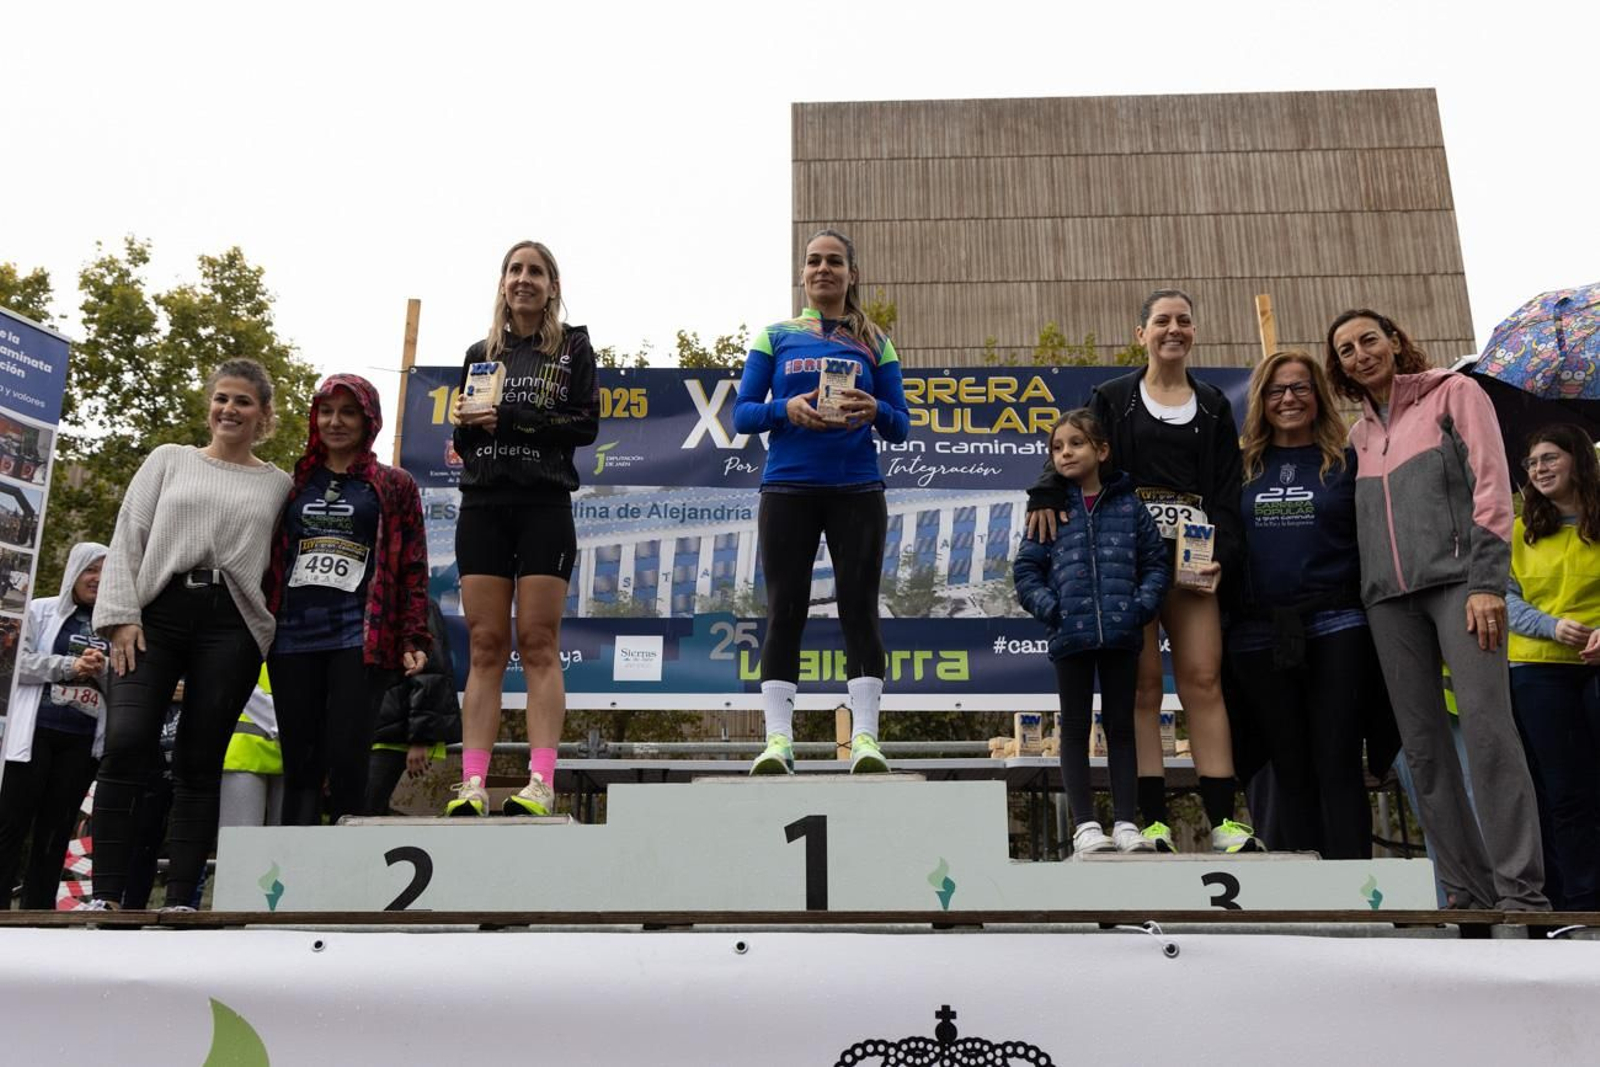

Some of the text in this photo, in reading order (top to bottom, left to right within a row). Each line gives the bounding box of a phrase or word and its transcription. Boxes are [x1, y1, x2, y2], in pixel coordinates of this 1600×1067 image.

[8, 331, 20, 345] la
[12, 388, 46, 408] valores
[935, 439, 1050, 455] caminat
[724, 455, 1002, 487] Por Integración
[1255, 486, 1314, 502] 25
[616, 503, 642, 518] de
[647, 502, 752, 523] Alejandría
[1150, 505, 1193, 526] 293
[305, 555, 349, 577] 496
[709, 622, 759, 661] 25
[621, 648, 657, 658] Sierras
[785, 815, 828, 911] 1
[384, 846, 433, 911] 2
[1201, 872, 1242, 911] 3
